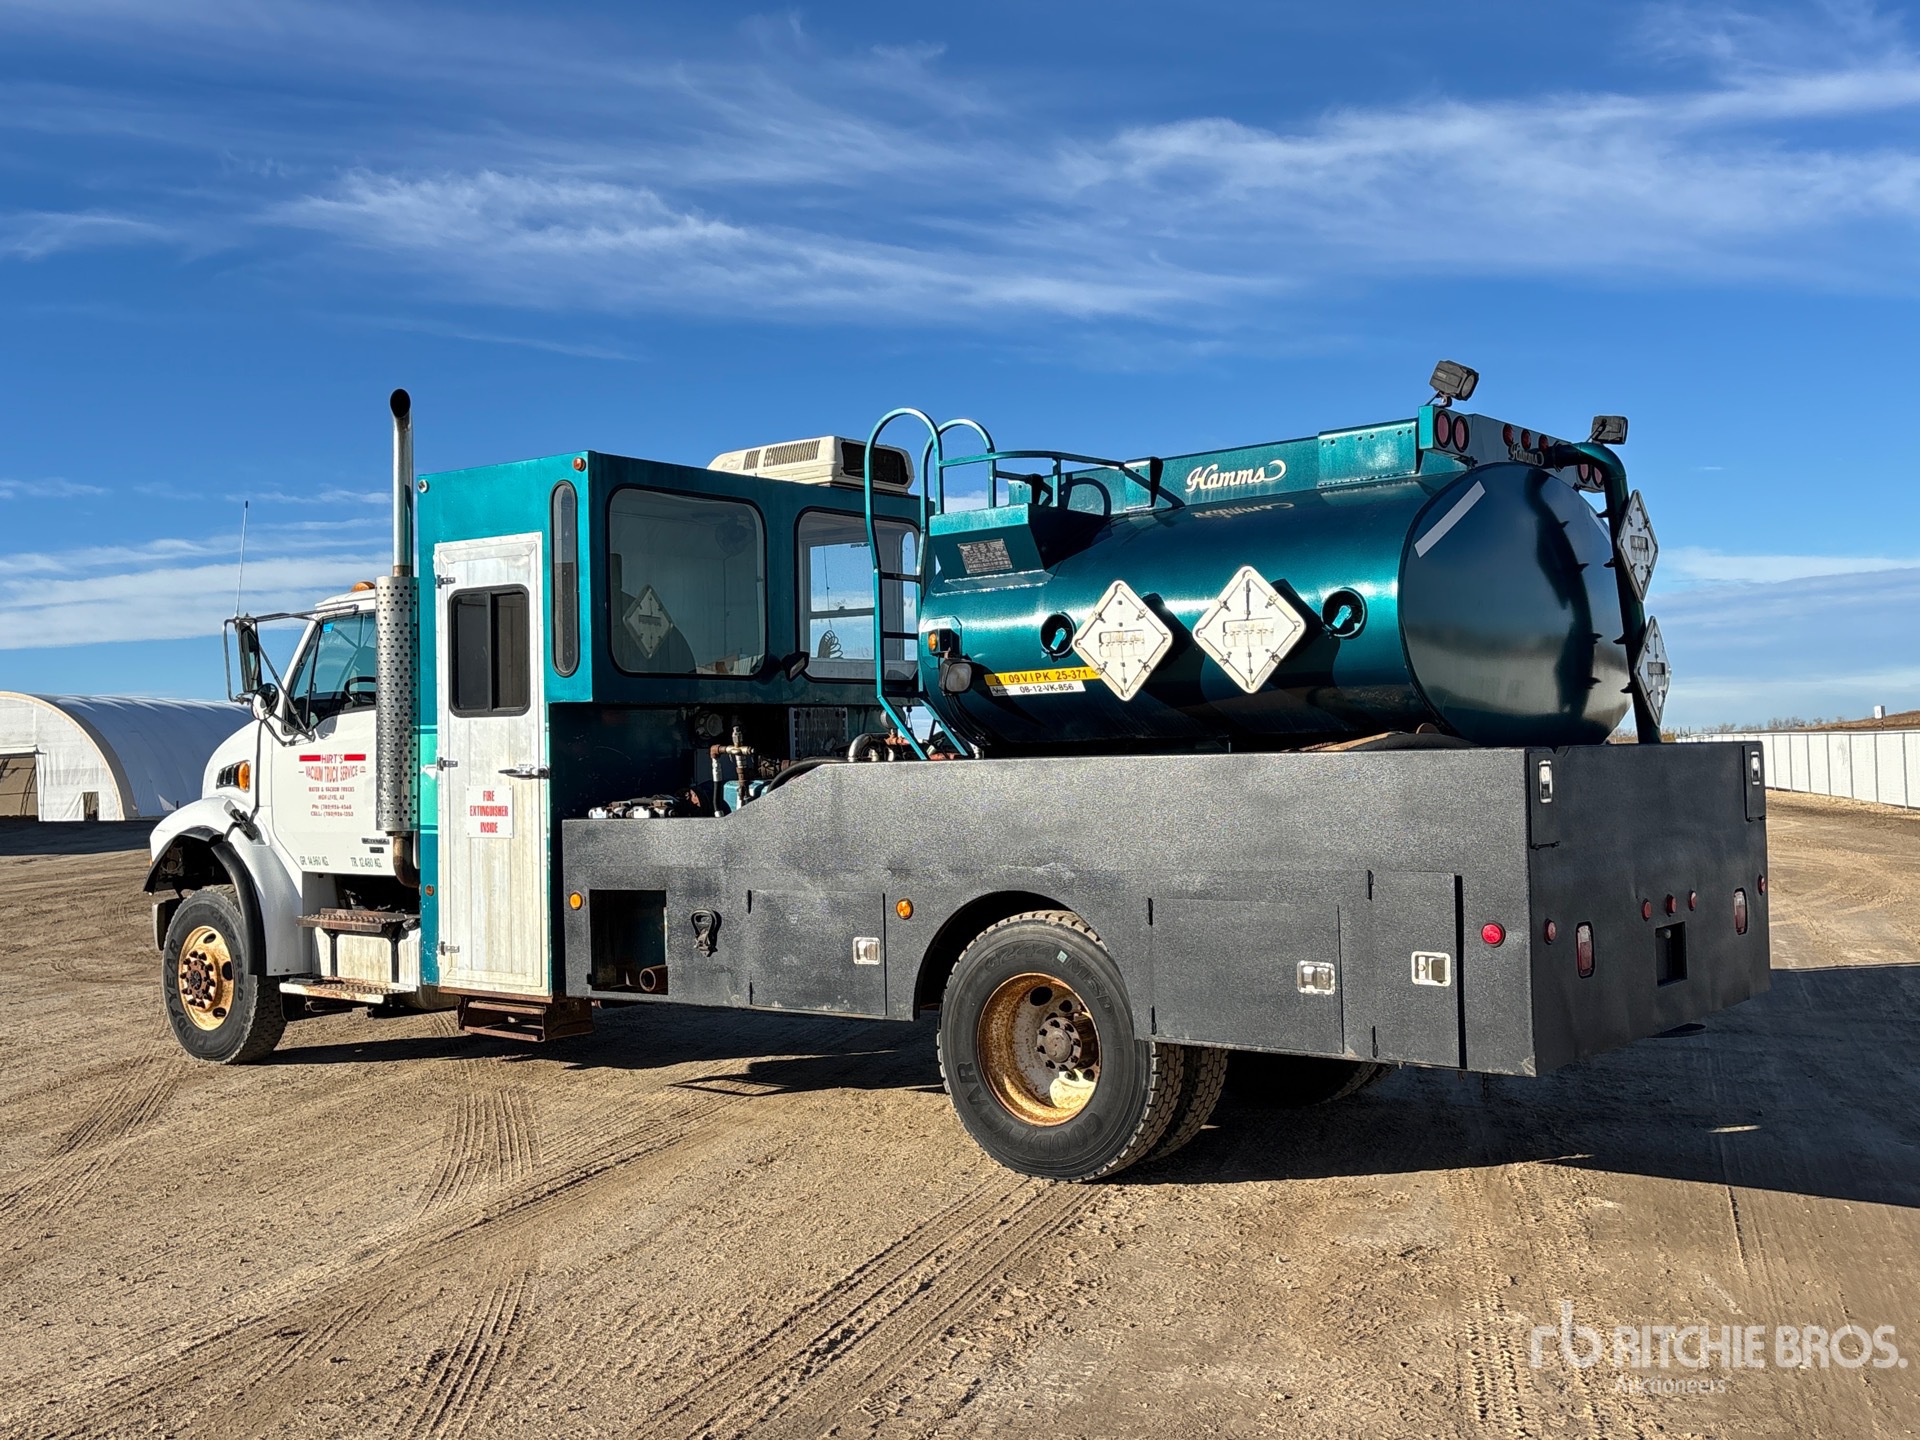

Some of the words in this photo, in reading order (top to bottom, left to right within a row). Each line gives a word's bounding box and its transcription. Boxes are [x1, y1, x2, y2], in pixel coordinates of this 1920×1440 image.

[1184, 459, 1287, 492] Hamms
[1055, 669, 1088, 681] 25-371
[1019, 683, 1075, 693] 08-12-VK-856
[305, 765, 323, 782] VACUUM
[324, 766, 339, 783] TRUCK
[340, 765, 358, 782] SERVICE
[482, 790, 495, 802] FIRE
[469, 805, 509, 817] EXTINGUISHER
[480, 822, 498, 833] INSIDE
